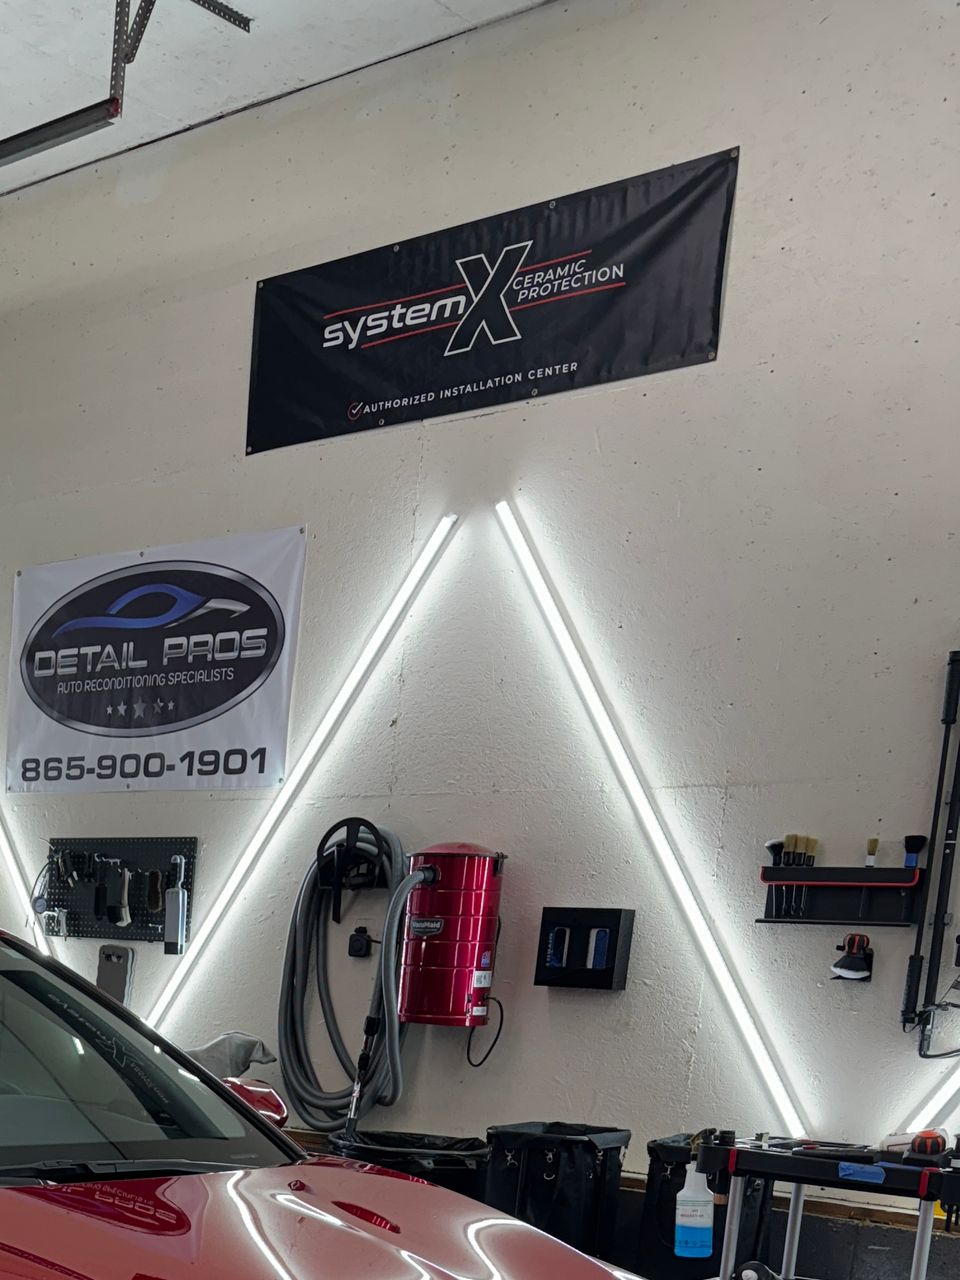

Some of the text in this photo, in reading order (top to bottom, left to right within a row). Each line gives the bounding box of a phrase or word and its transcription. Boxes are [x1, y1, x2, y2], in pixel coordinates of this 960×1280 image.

[512, 259, 586, 290] CERAMIC
[517, 264, 624, 302] PROTECTION
[363, 361, 579, 414] AUTHORIZED INSTALLATION CENTER
[33, 628, 268, 678] DETAIL PROS
[57, 667, 234, 694] AUTO RECONDITIONING SPECIALISTS
[21, 747, 267, 782] 865-900-1901
